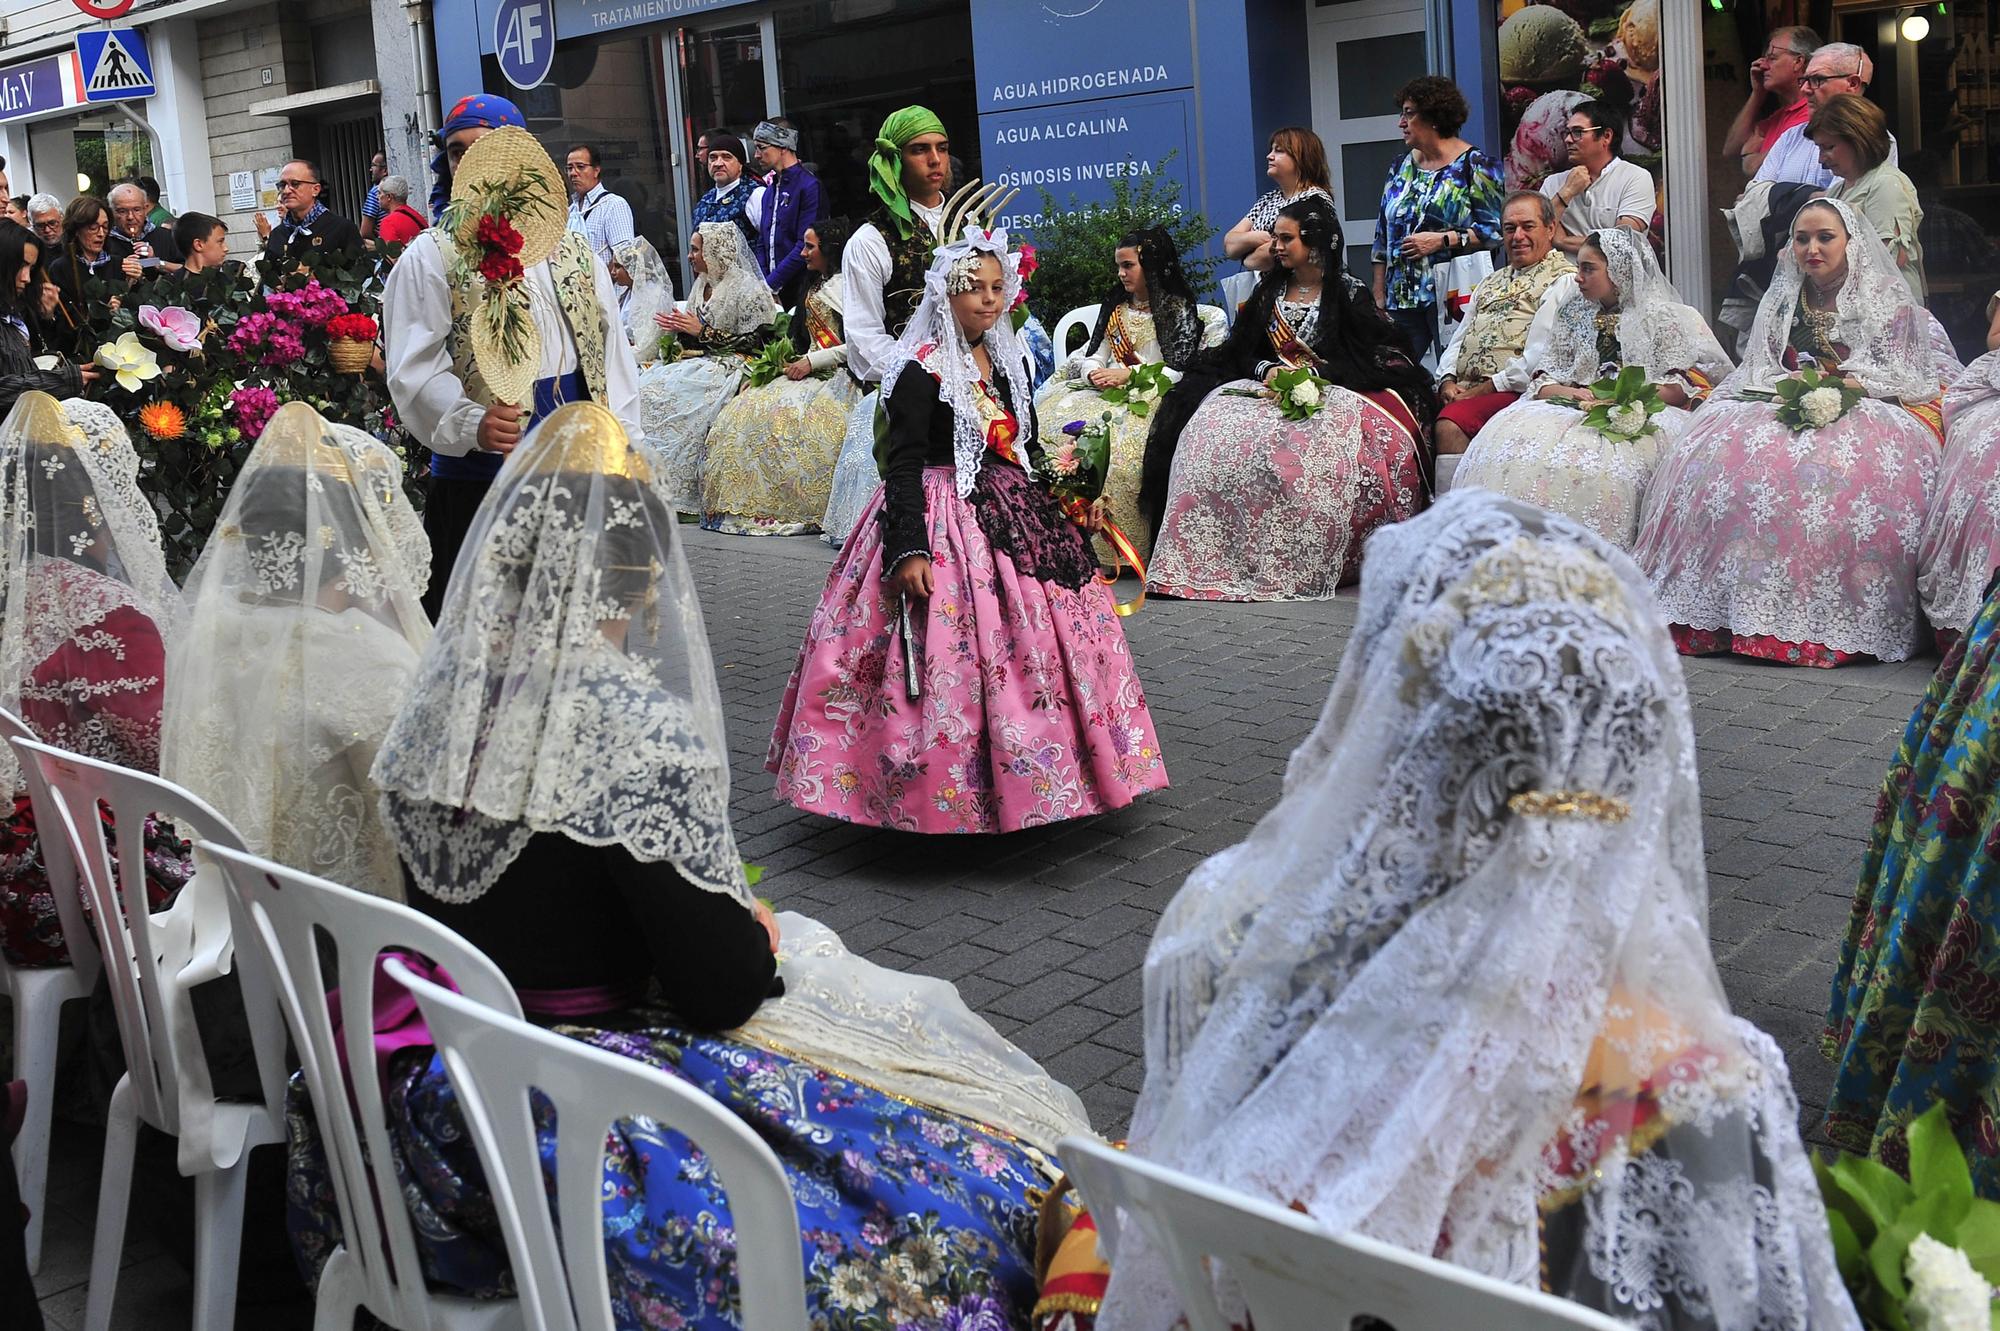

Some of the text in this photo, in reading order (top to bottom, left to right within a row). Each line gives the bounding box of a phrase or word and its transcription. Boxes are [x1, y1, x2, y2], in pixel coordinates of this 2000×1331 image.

[592, 0, 682, 27] TRATAMIENTO
[501, 3, 542, 65] AF
[993, 65, 1168, 101] AGUA HIDROGENADA
[404, 112, 419, 135] 34
[996, 117, 1129, 144] AGUA ALCALINA
[999, 161, 1152, 187] OSMOSIS INVERSA
